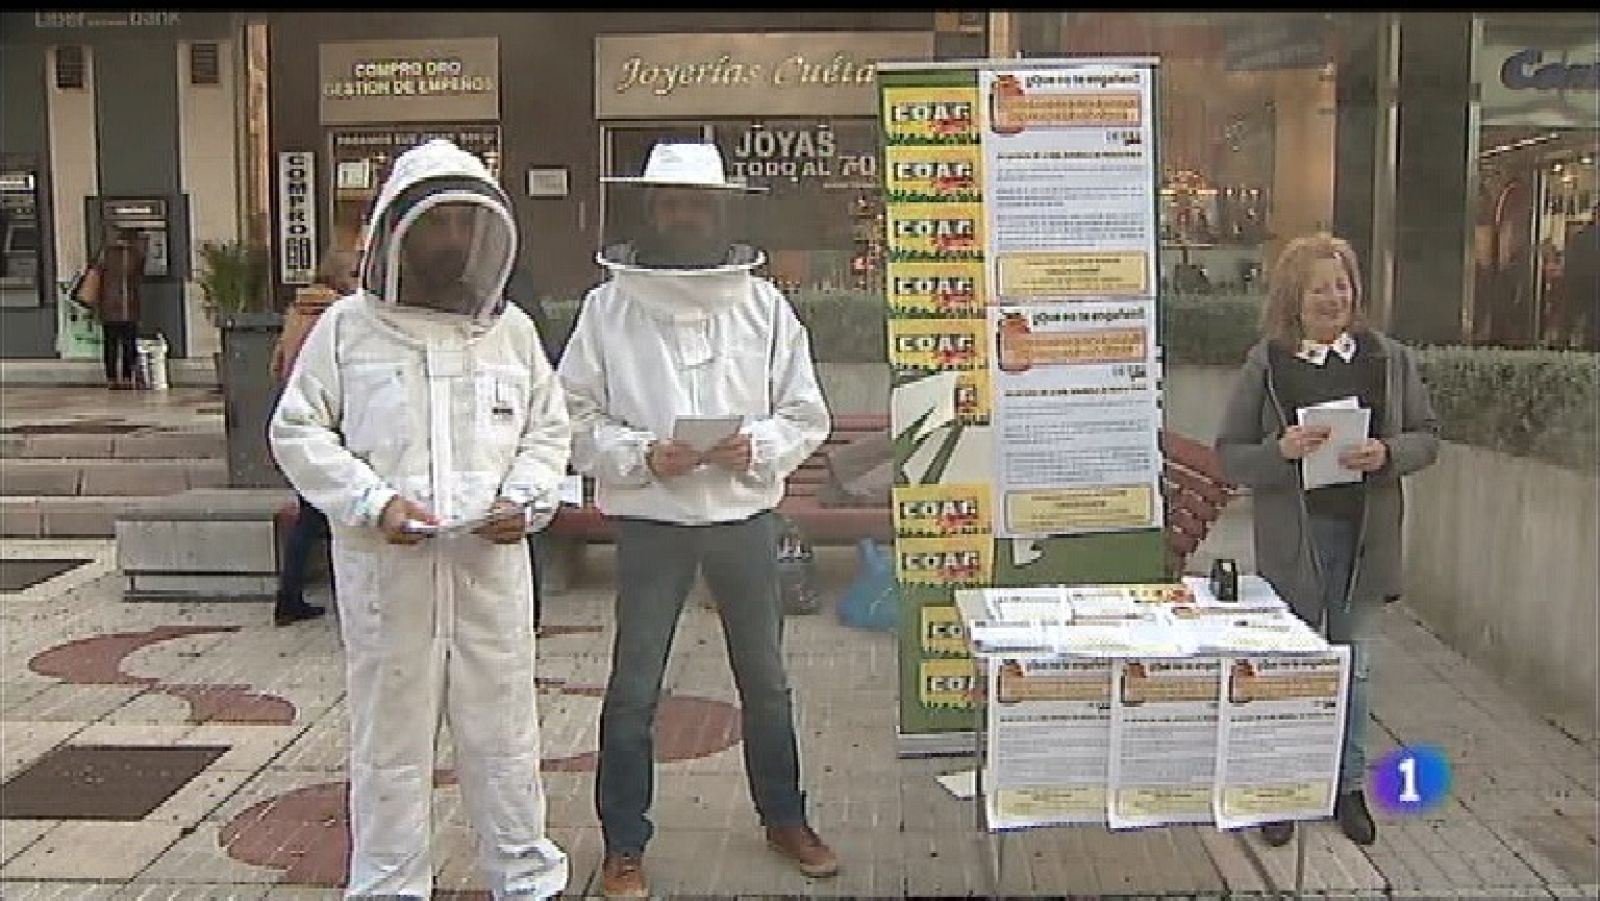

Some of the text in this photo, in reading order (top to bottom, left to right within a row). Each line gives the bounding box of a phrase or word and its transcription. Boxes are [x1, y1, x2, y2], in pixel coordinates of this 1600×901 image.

[354, 61, 462, 77] COMPRO ORO
[616, 54, 762, 95] Joyerías
[393, 80, 416, 95] DE
[735, 129, 837, 158] JOYAS
[803, 161, 831, 176] AL
[288, 155, 307, 235] COMPRO
